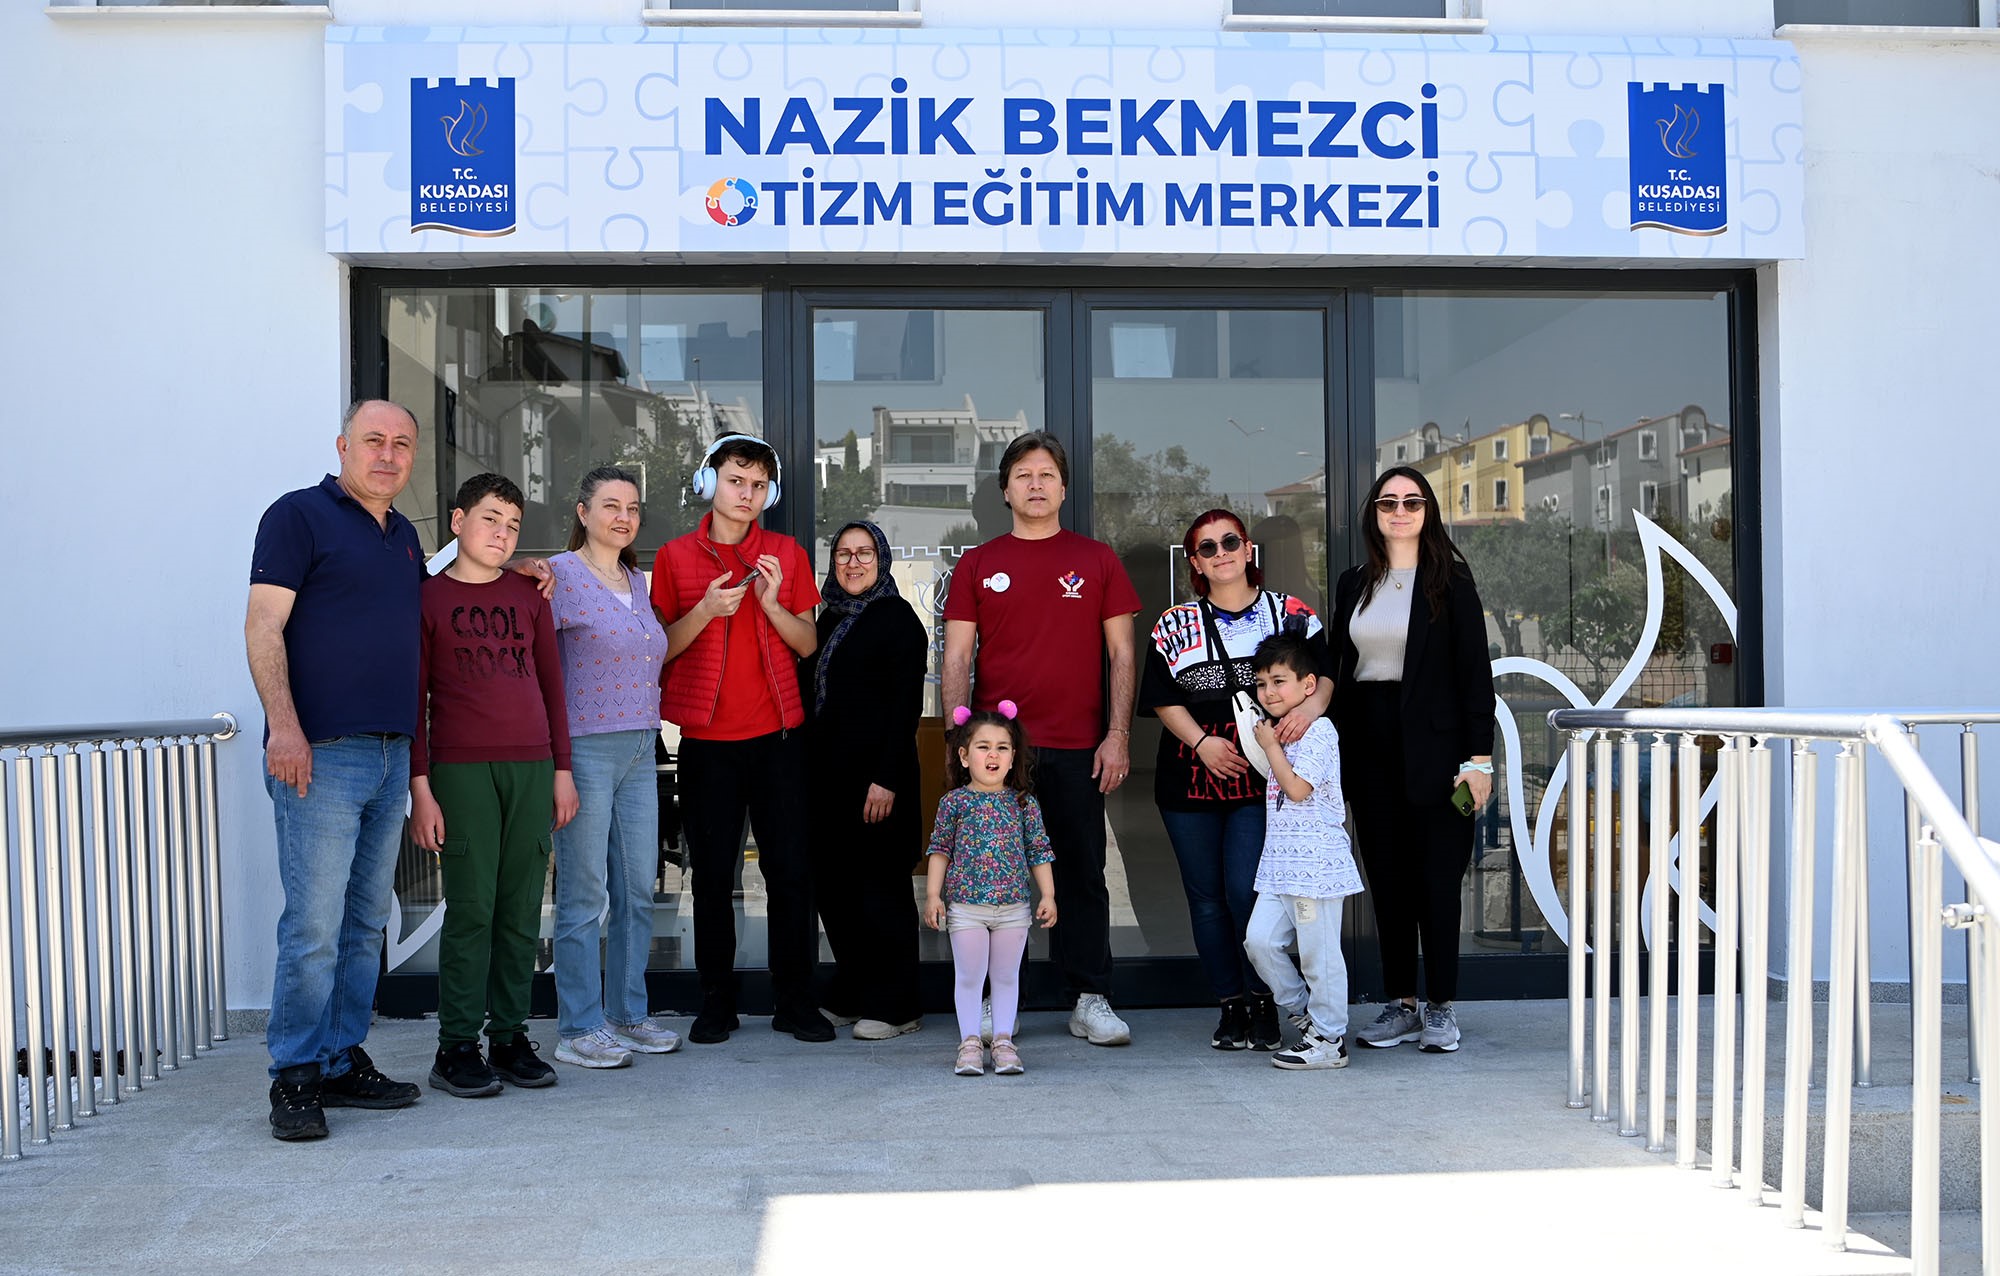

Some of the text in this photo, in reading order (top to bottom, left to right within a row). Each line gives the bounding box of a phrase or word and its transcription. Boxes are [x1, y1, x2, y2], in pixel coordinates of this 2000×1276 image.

[705, 77, 1439, 160] NAZİK BEKMEZCİ
[452, 167, 479, 180] T.C.
[1668, 169, 1692, 181] T.C.
[420, 184, 509, 200] KUŞADASI
[933, 166, 1145, 227] EĞİTİM
[1165, 170, 1440, 228] MERKEZİ
[1638, 184, 1720, 200] KUŞADASI
[420, 200, 508, 213] BELEDİYESİ
[1638, 200, 1720, 213] BELEDİYESİ
[451, 606, 524, 640] COOL
[454, 645, 531, 680] ROCK
